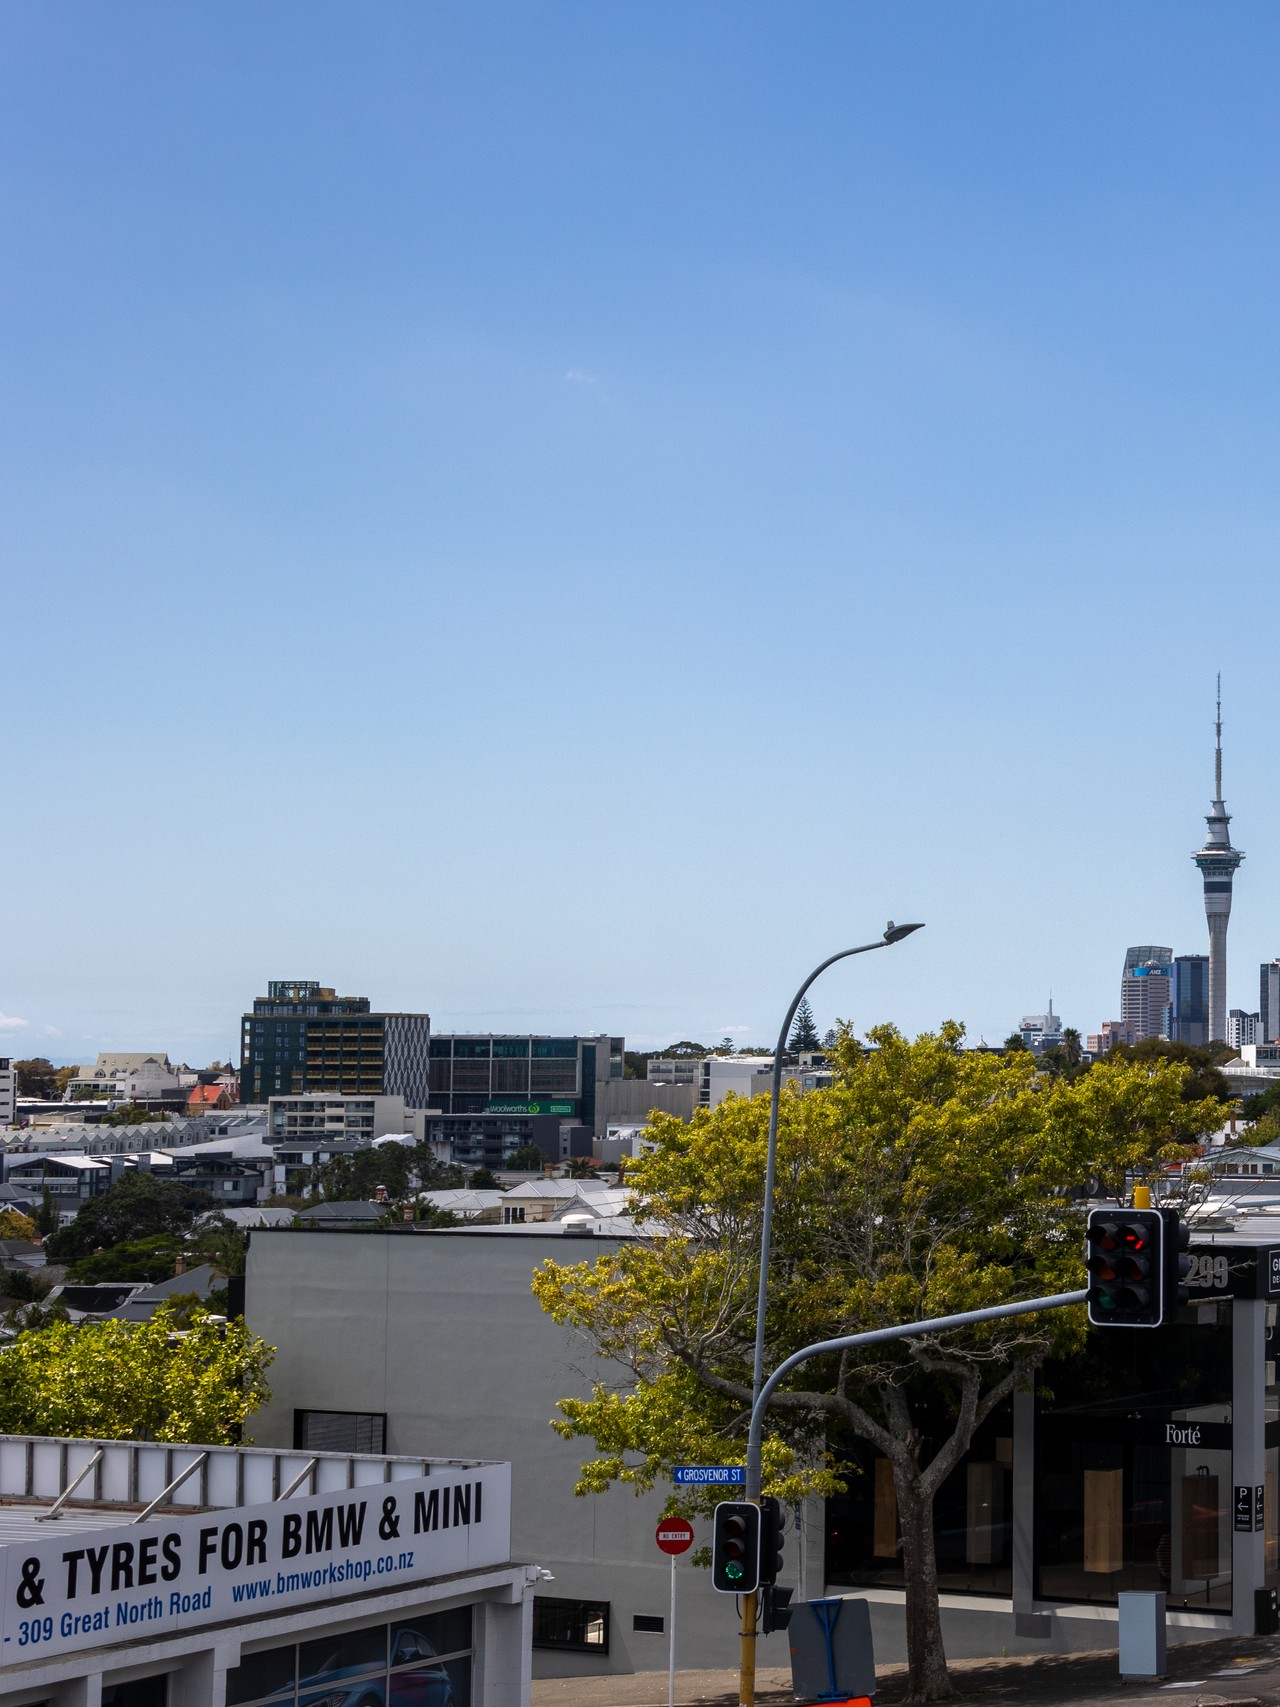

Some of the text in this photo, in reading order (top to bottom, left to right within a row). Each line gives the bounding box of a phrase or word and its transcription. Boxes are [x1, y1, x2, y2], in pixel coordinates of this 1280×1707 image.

[1184, 1255, 1229, 1288] 299
[1165, 1423, 1201, 1445] Forté
[683, 1468, 741, 1482] GROSVENOR ST
[1240, 1487, 1248, 1499] P
[1257, 1487, 1263, 1499] P
[16, 1481, 482, 1609] & TYRES FOR BMW & MINI
[671, 1532, 687, 1540] ENTRY
[18, 1616, 54, 1646] 309
[60, 1607, 110, 1638] Great
[116, 1595, 163, 1627] North
[169, 1585, 212, 1616] Road
[232, 1551, 415, 1603] www.bmworkshop.co.nz
